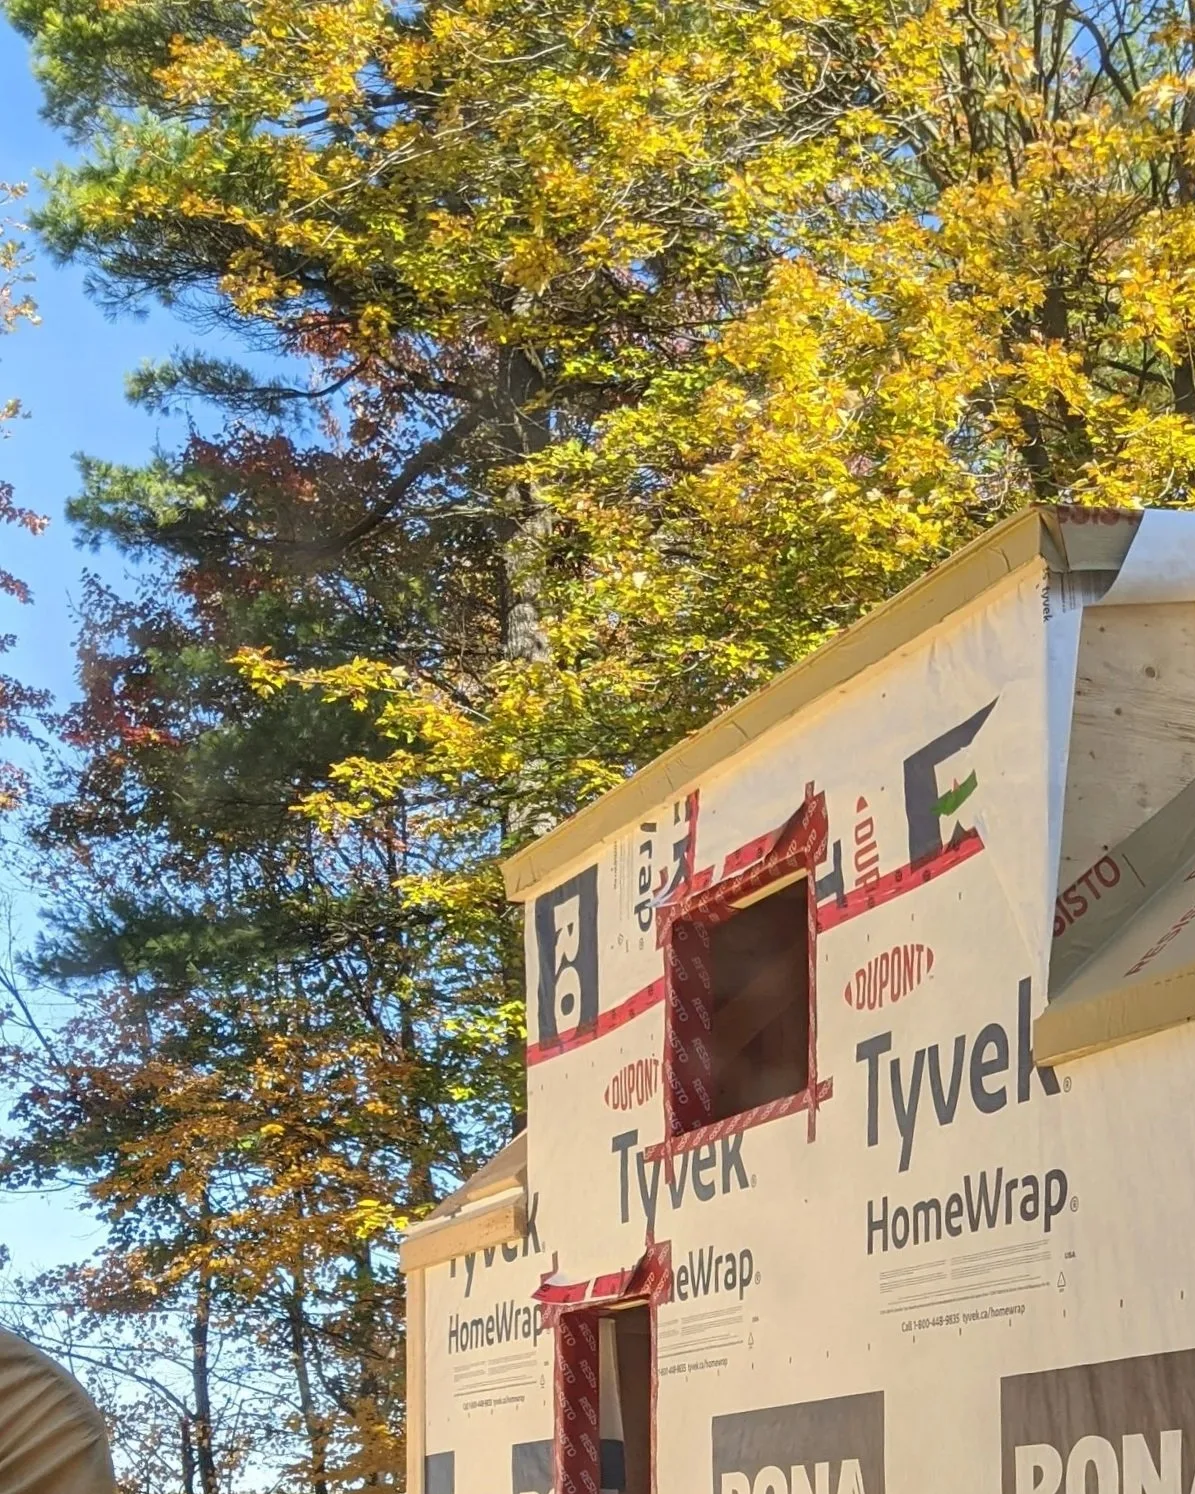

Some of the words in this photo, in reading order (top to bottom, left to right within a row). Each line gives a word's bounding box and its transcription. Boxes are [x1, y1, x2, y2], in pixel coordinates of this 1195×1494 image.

[855, 943, 925, 1011] DUPONT
[612, 1058, 660, 1111] DUPONT
[856, 976, 1061, 1173] Tyvek
[867, 1167, 1068, 1255] HomeWrap
[448, 1300, 542, 1355] HomeWrap
